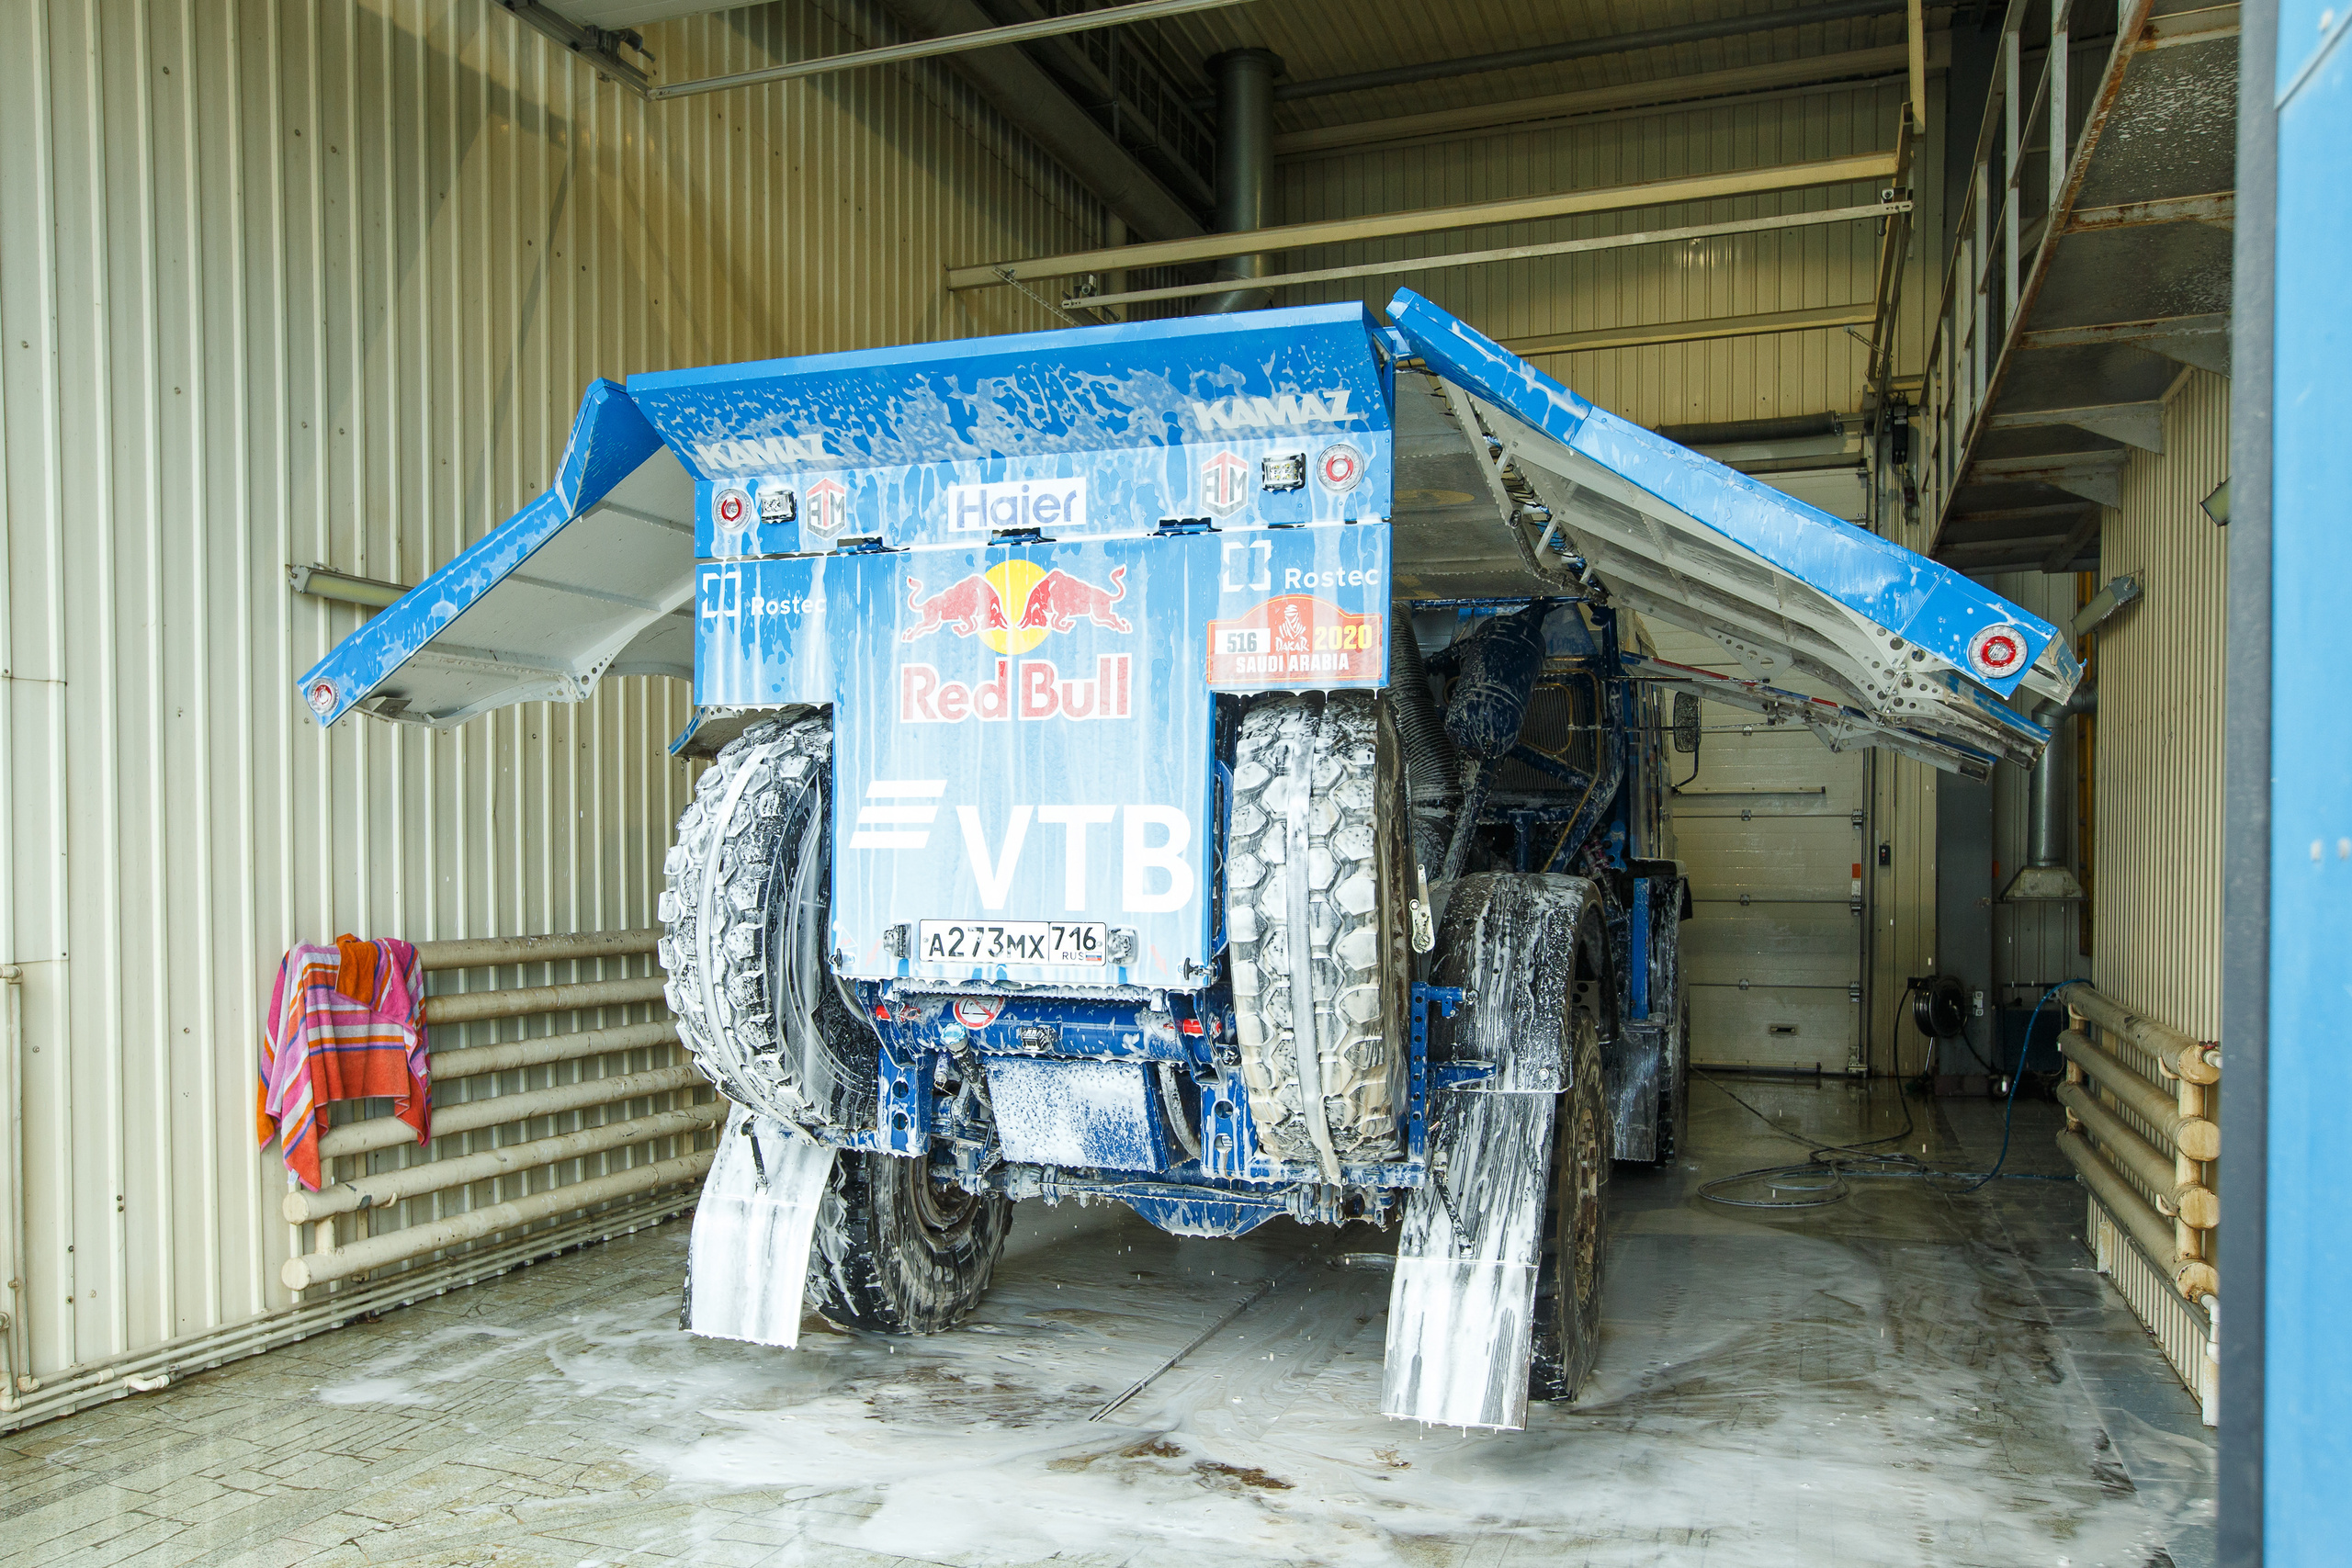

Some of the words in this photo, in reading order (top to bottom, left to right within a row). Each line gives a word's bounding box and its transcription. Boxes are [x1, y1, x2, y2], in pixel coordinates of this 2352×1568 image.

[1192, 390, 1359, 431] KAMAZ
[695, 434, 837, 469] KAMAZ
[956, 484, 1077, 528] Haier
[1285, 567, 1379, 590] Rostec
[751, 596, 826, 615] Rostec
[1227, 632, 1258, 653] 516
[1314, 624, 1373, 650] 2020
[1275, 636, 1309, 652] DAKAR
[1236, 655, 1283, 673] SAUDI
[1288, 653, 1350, 671] ARABIA
[902, 659, 1009, 721] Red
[1022, 656, 1129, 718] Bull
[956, 804, 1194, 913] VTB
[1052, 926, 1097, 951] 716
[1062, 951, 1084, 961] RUS
